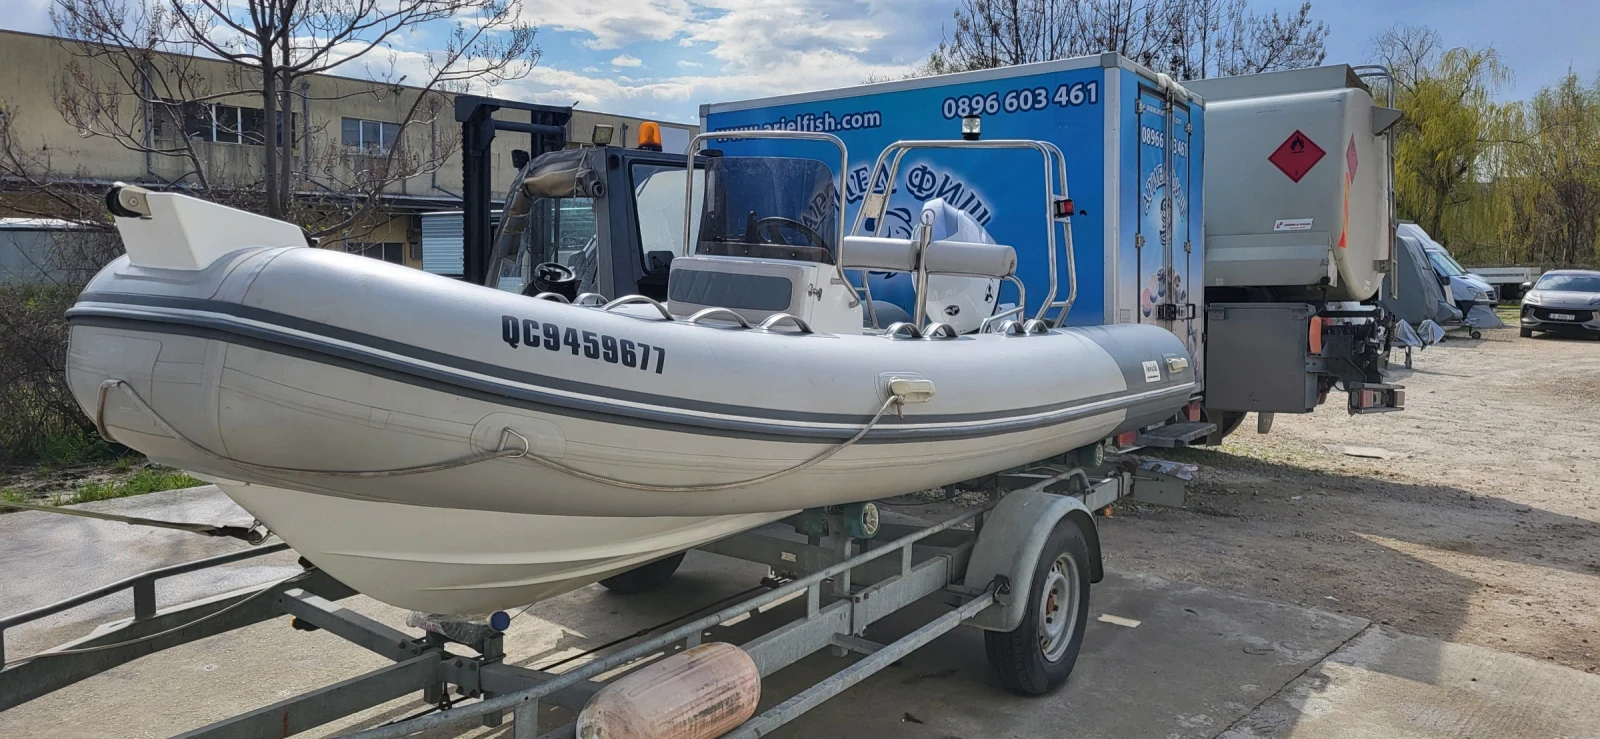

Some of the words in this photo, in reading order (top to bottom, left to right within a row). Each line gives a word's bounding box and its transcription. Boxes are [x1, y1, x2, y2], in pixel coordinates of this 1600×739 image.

[943, 94, 999, 118] 0896
[1004, 89, 1047, 112] 603
[1054, 82, 1097, 106] 461
[715, 111, 880, 142] arielfish.com
[502, 315, 666, 375] QC9459677
